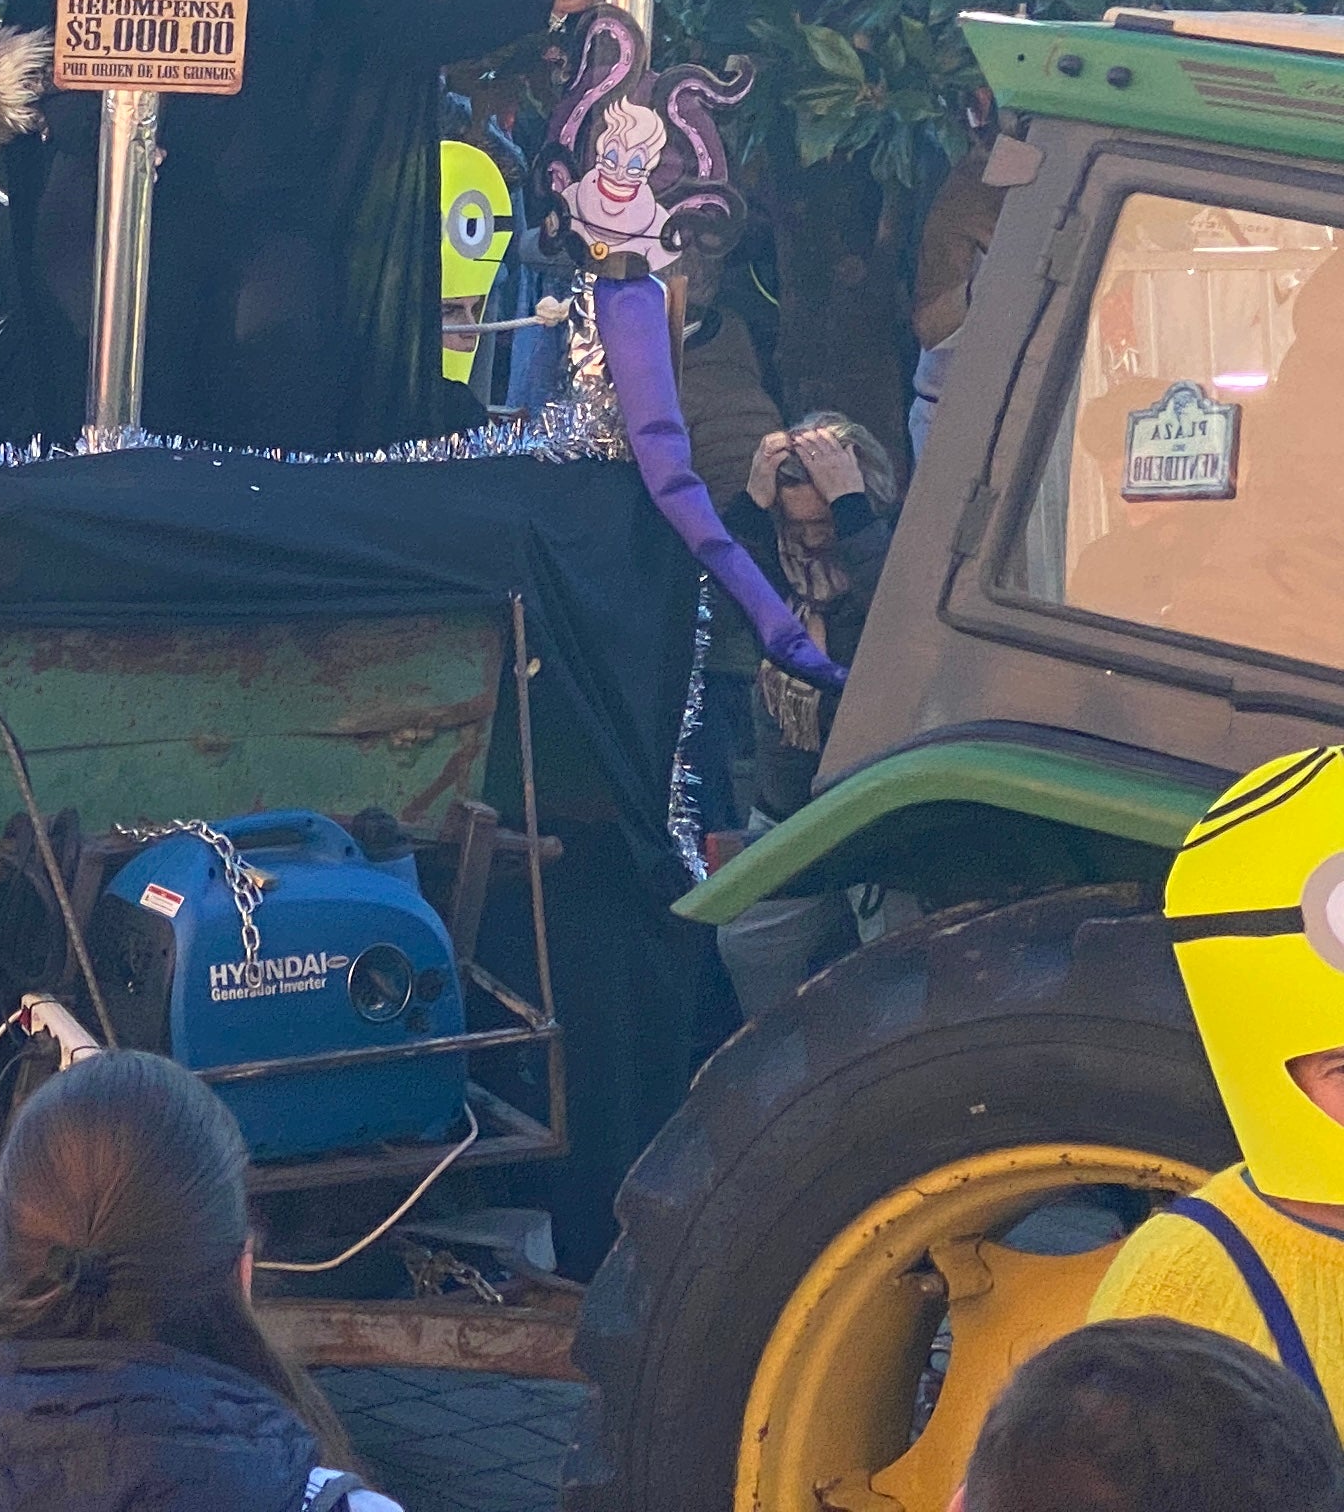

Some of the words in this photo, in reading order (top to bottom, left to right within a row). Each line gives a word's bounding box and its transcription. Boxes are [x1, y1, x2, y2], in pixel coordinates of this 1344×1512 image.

[66, 16, 234, 55] $5,000.00
[63, 62, 87, 76] POR
[91, 63, 133, 77] ORDEN
[138, 63, 152, 79] DE
[157, 65, 179, 79] LOS
[184, 66, 236, 80] GRINGOS
[210, 952, 327, 987] HYUNDAI
[211, 982, 277, 1001] Generador
[280, 978, 328, 994] Inverter
